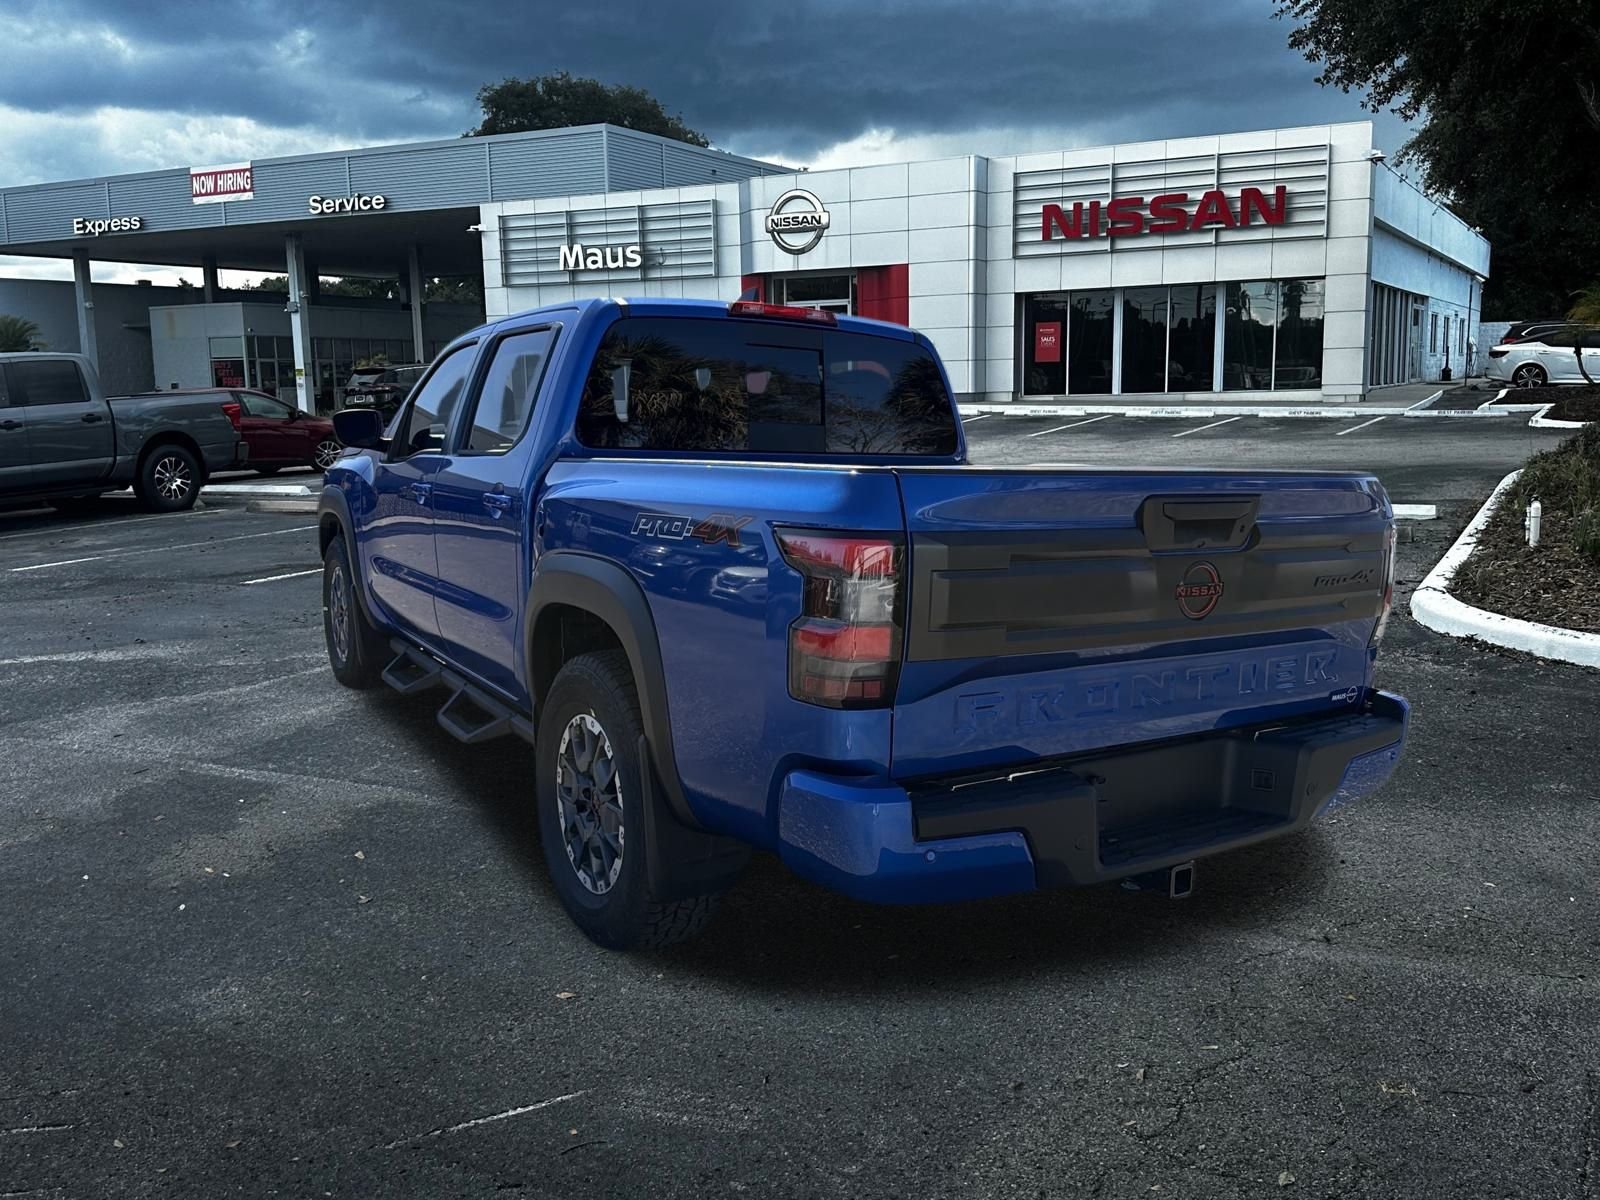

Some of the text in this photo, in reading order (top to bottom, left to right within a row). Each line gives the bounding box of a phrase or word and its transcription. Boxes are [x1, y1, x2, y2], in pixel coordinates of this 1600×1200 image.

[192, 171, 251, 195] NOW HIRING
[308, 193, 385, 215] Service
[1041, 185, 1287, 241] NISSAN
[73, 216, 141, 237] Express
[770, 214, 822, 230] NISSAN
[559, 243, 642, 271] Maus
[1176, 584, 1222, 597] NISSAN
[953, 649, 1338, 738] FRONTIER
